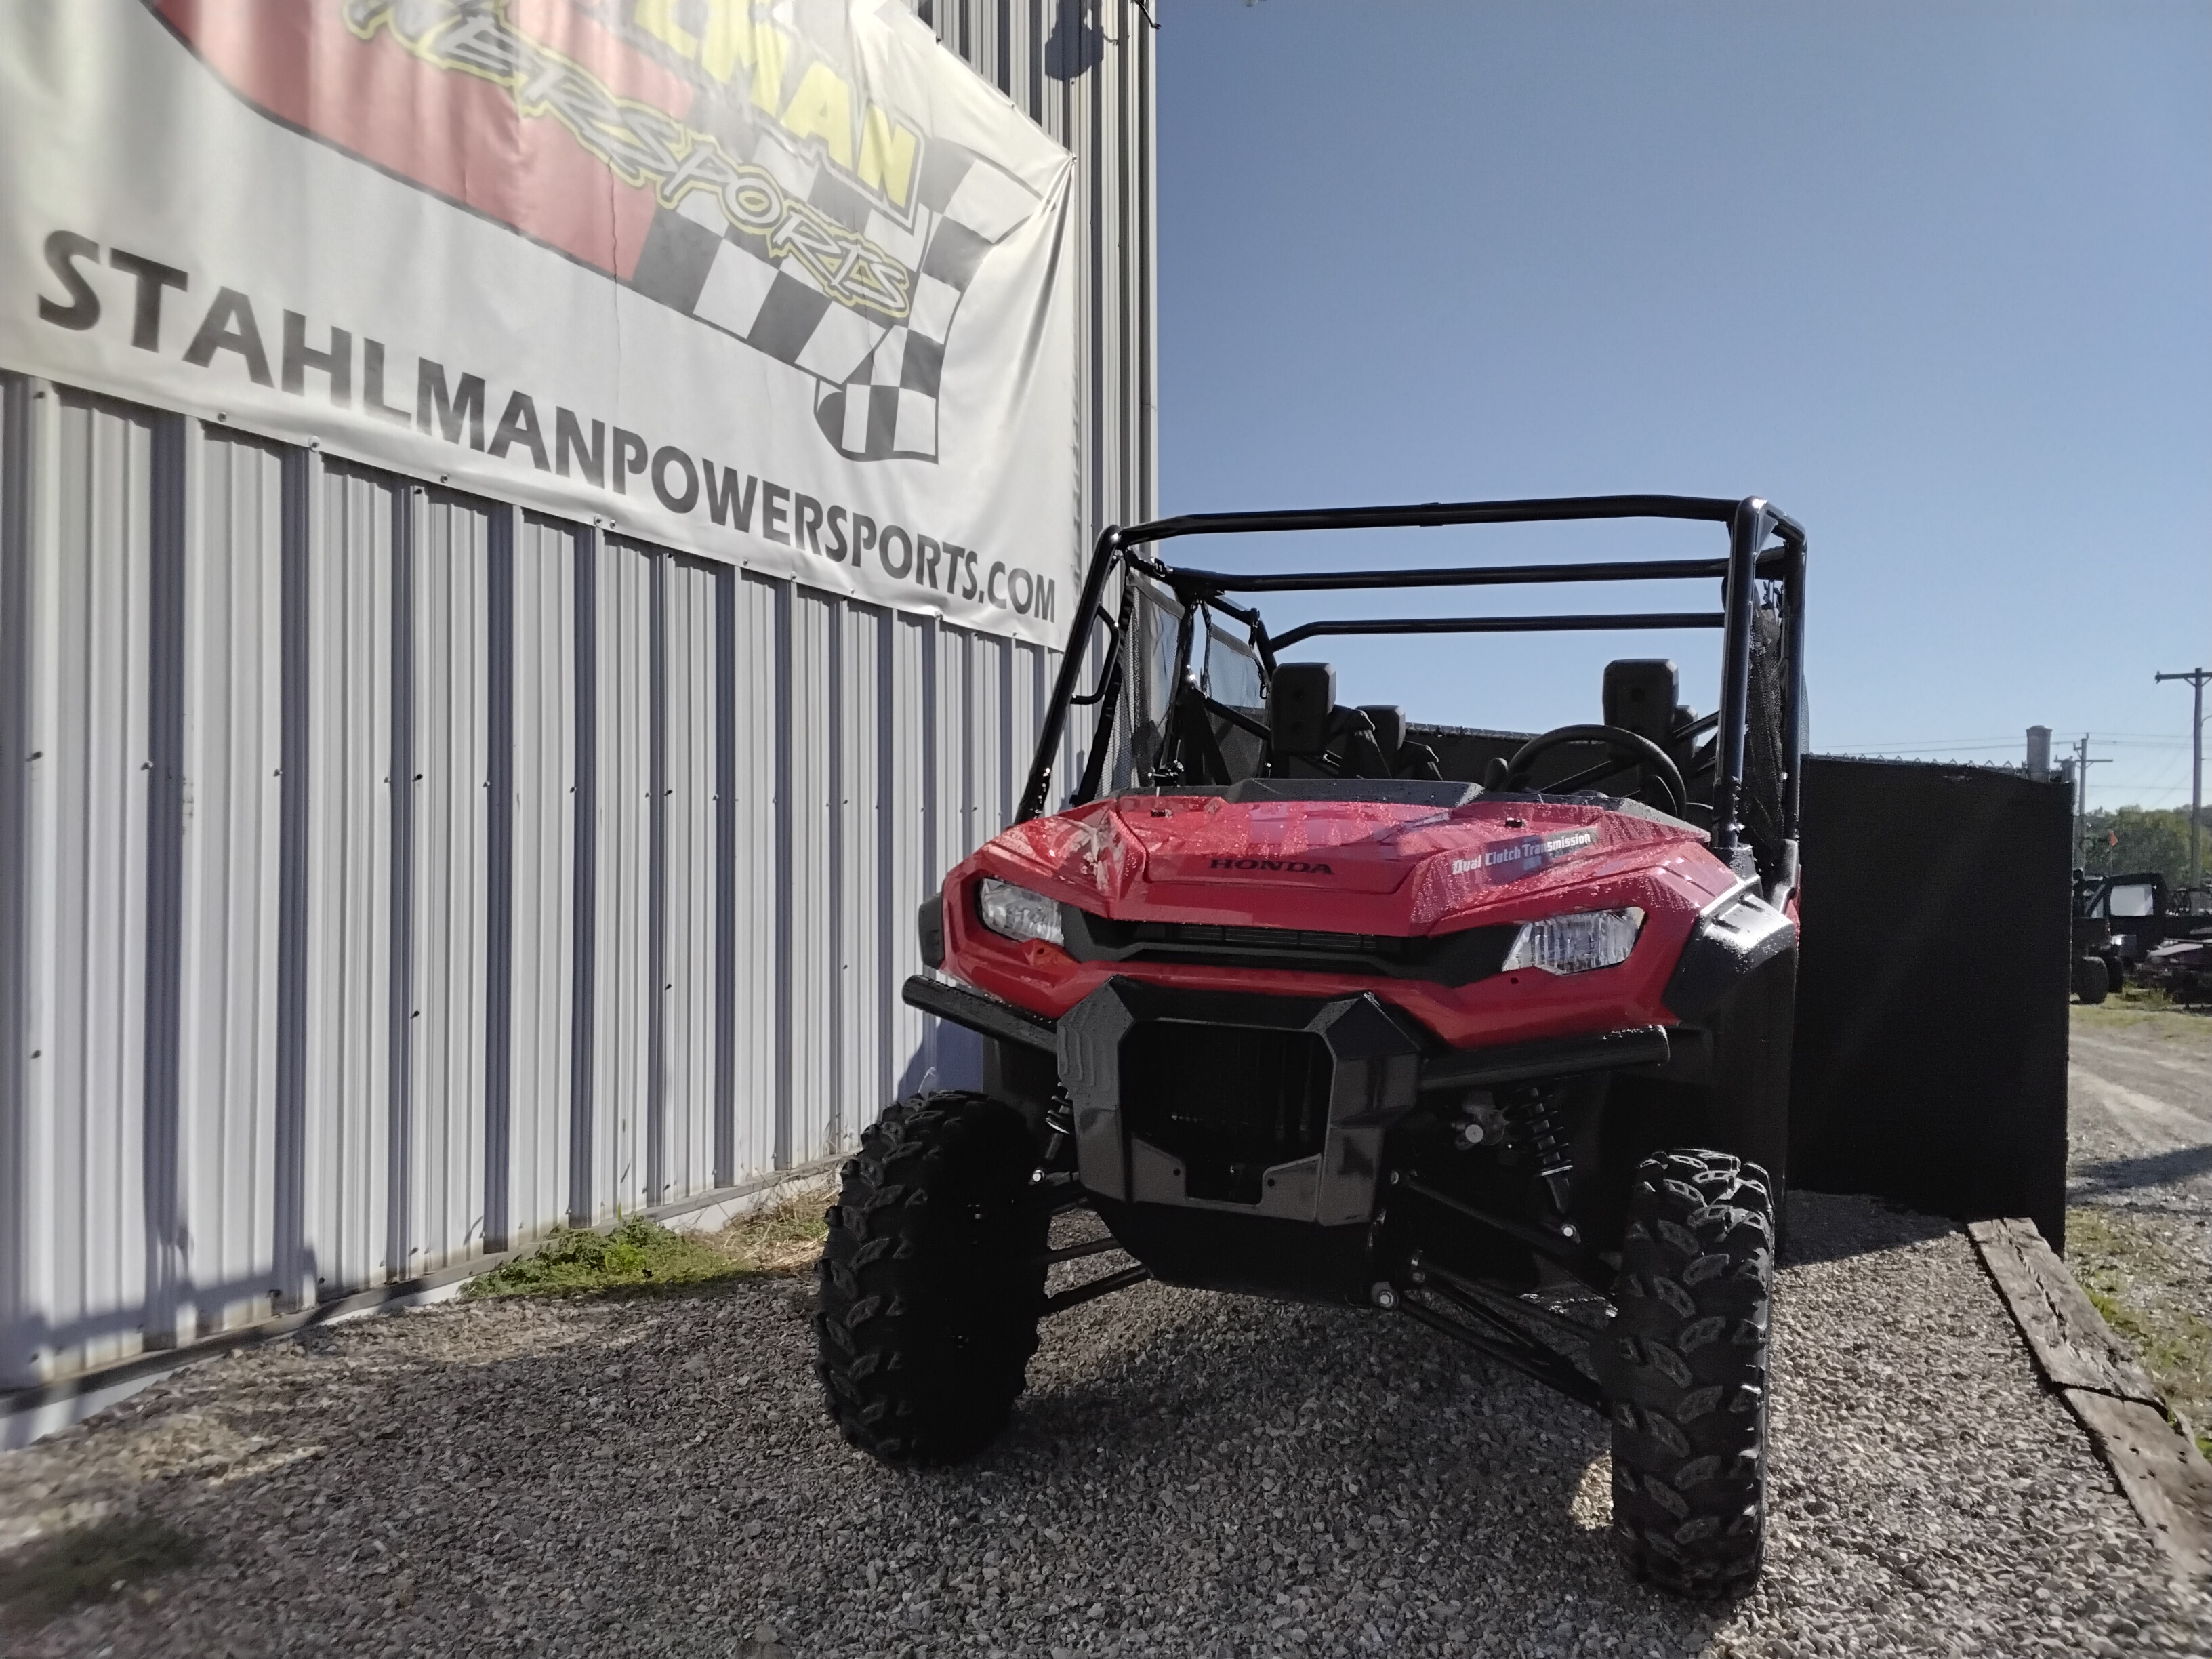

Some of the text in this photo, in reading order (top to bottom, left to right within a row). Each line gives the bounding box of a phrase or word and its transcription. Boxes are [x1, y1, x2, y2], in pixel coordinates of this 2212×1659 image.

[38, 230, 1056, 623] STAHLMANPOWERSPORTS.COM
[1209, 859, 1336, 875] HONDA
[1452, 833, 1591, 875] Dual Clutch Transmission
